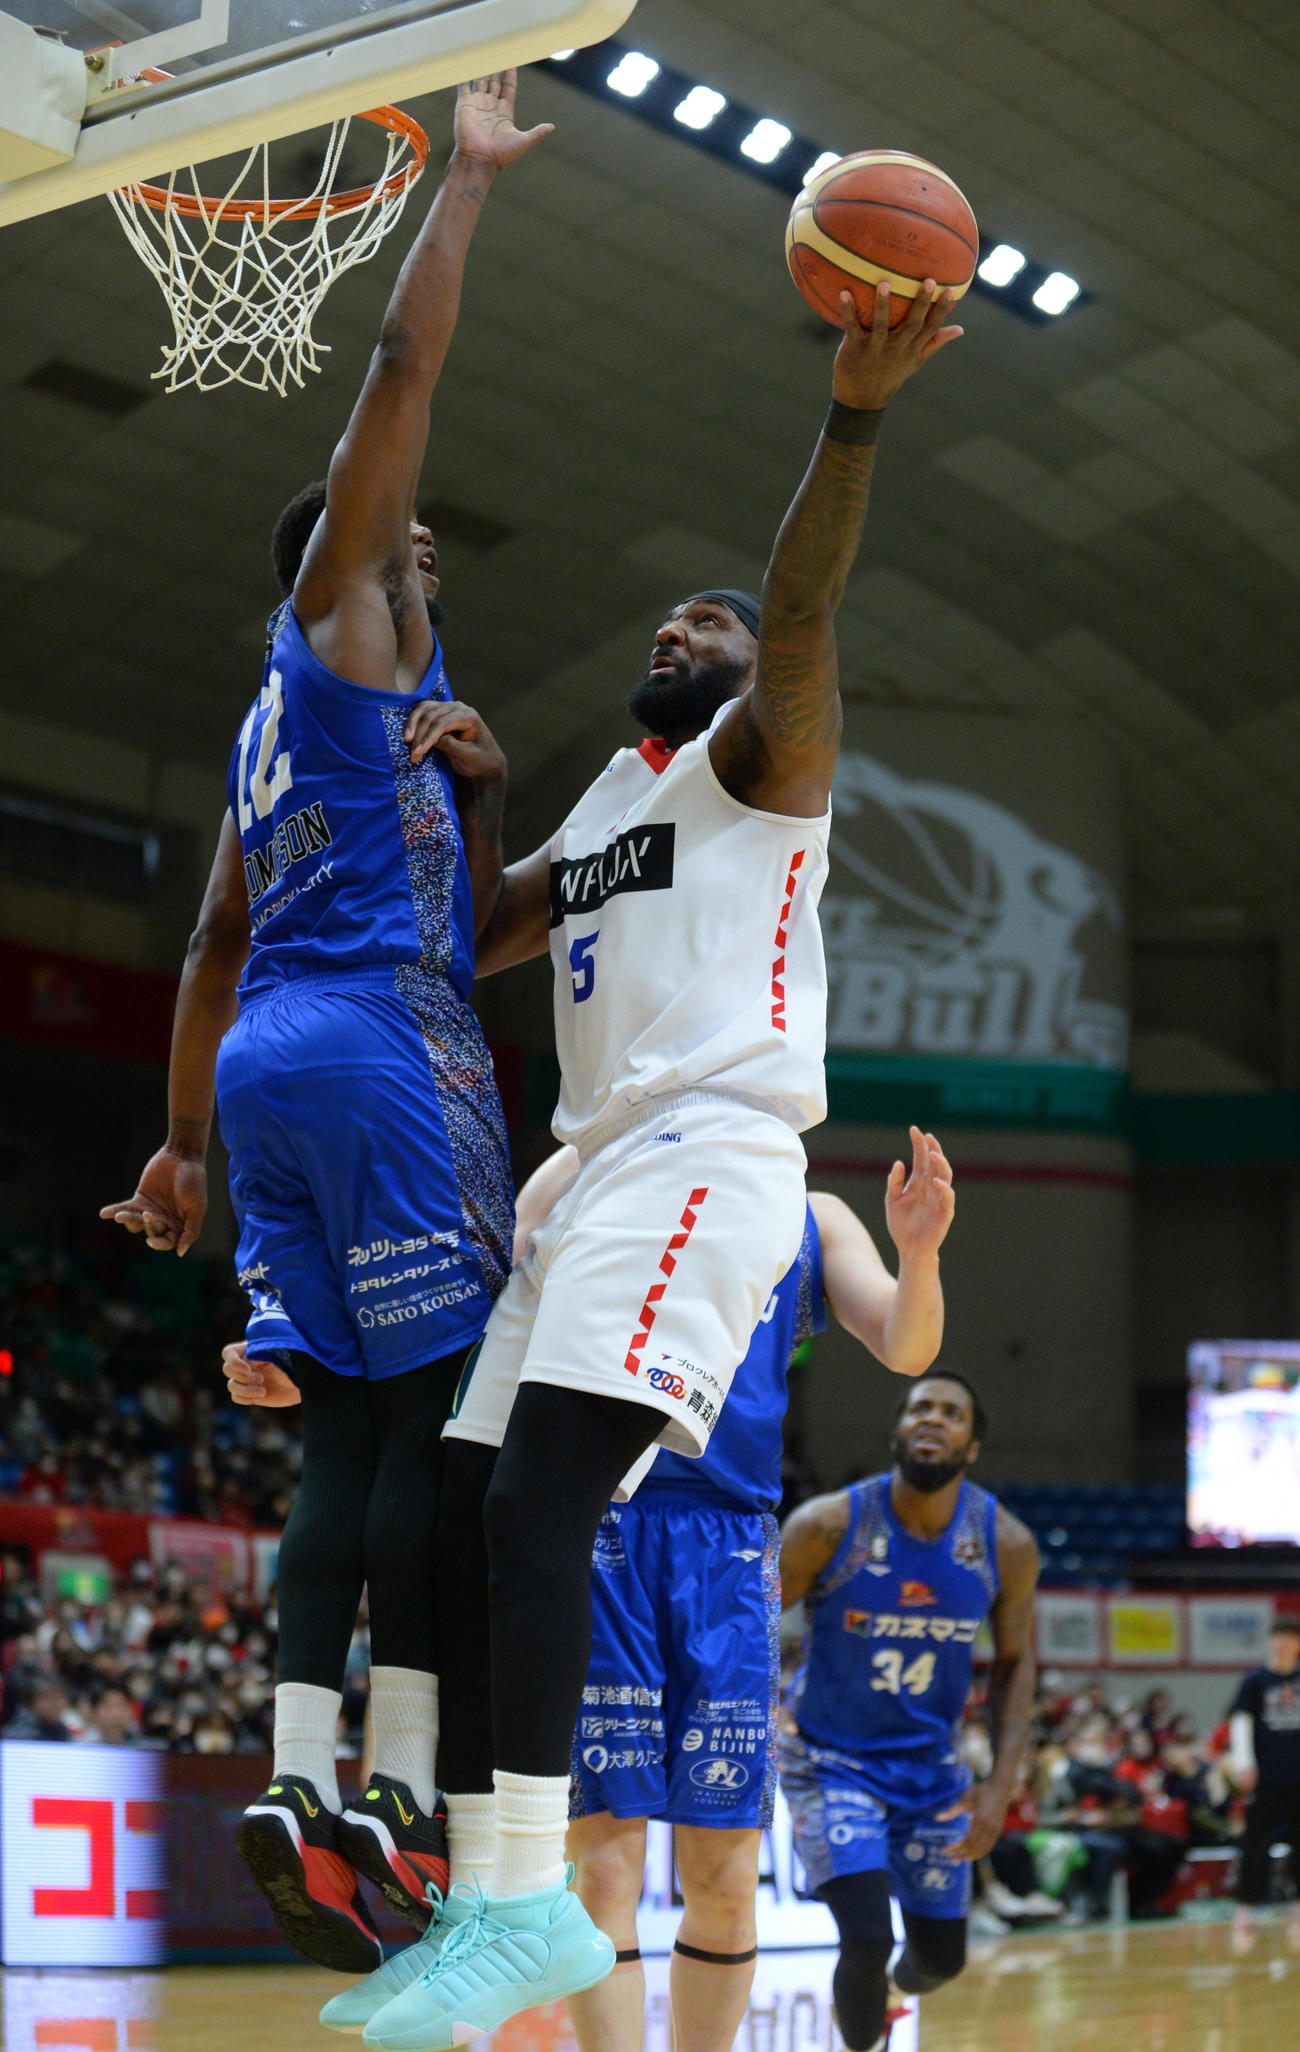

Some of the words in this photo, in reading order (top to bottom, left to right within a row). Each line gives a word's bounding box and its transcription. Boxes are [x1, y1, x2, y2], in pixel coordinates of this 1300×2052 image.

[237, 669, 293, 836] 12
[569, 930, 600, 1004] 5
[377, 1306, 418, 1327] SATO
[419, 1281, 481, 1315] KOUSAN
[870, 1649, 937, 1695] 34
[709, 1740, 756, 1754] BIJIN
[711, 1727, 766, 1740] NANBU
